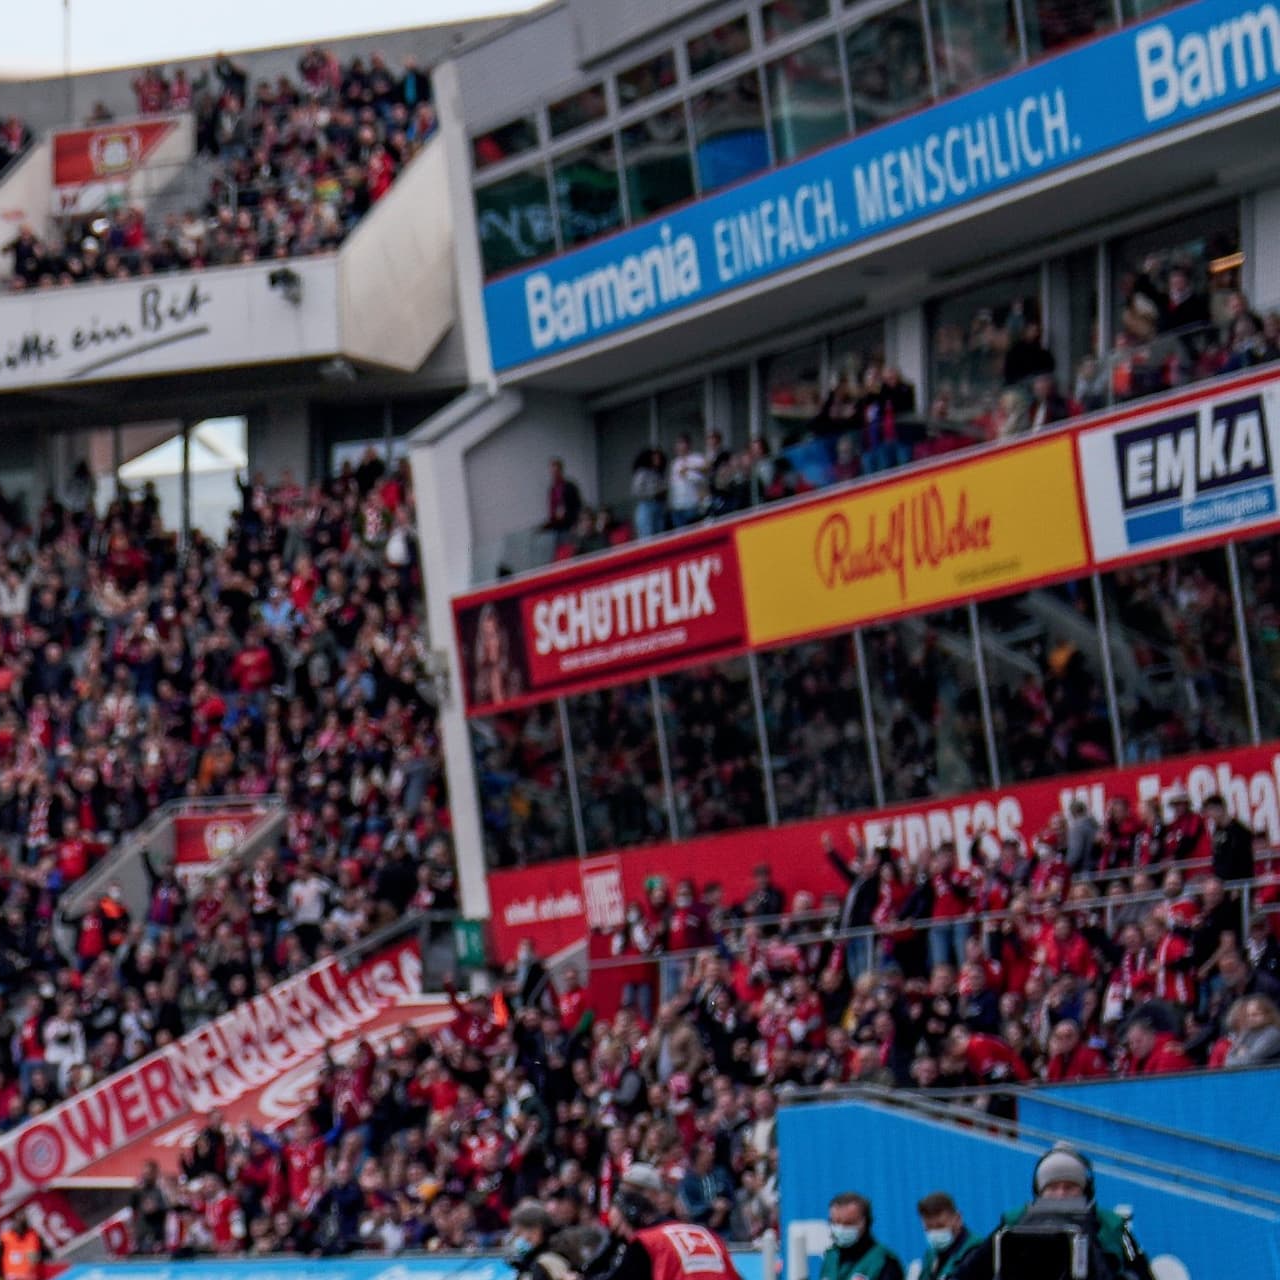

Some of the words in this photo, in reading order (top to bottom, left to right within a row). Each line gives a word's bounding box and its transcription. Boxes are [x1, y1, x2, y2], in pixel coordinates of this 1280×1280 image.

[1135, 3, 1280, 122] Barm
[524, 222, 702, 349] Barmenia
[713, 178, 849, 282] EINFACH.
[852, 87, 1082, 228] MENSCHLICH.
